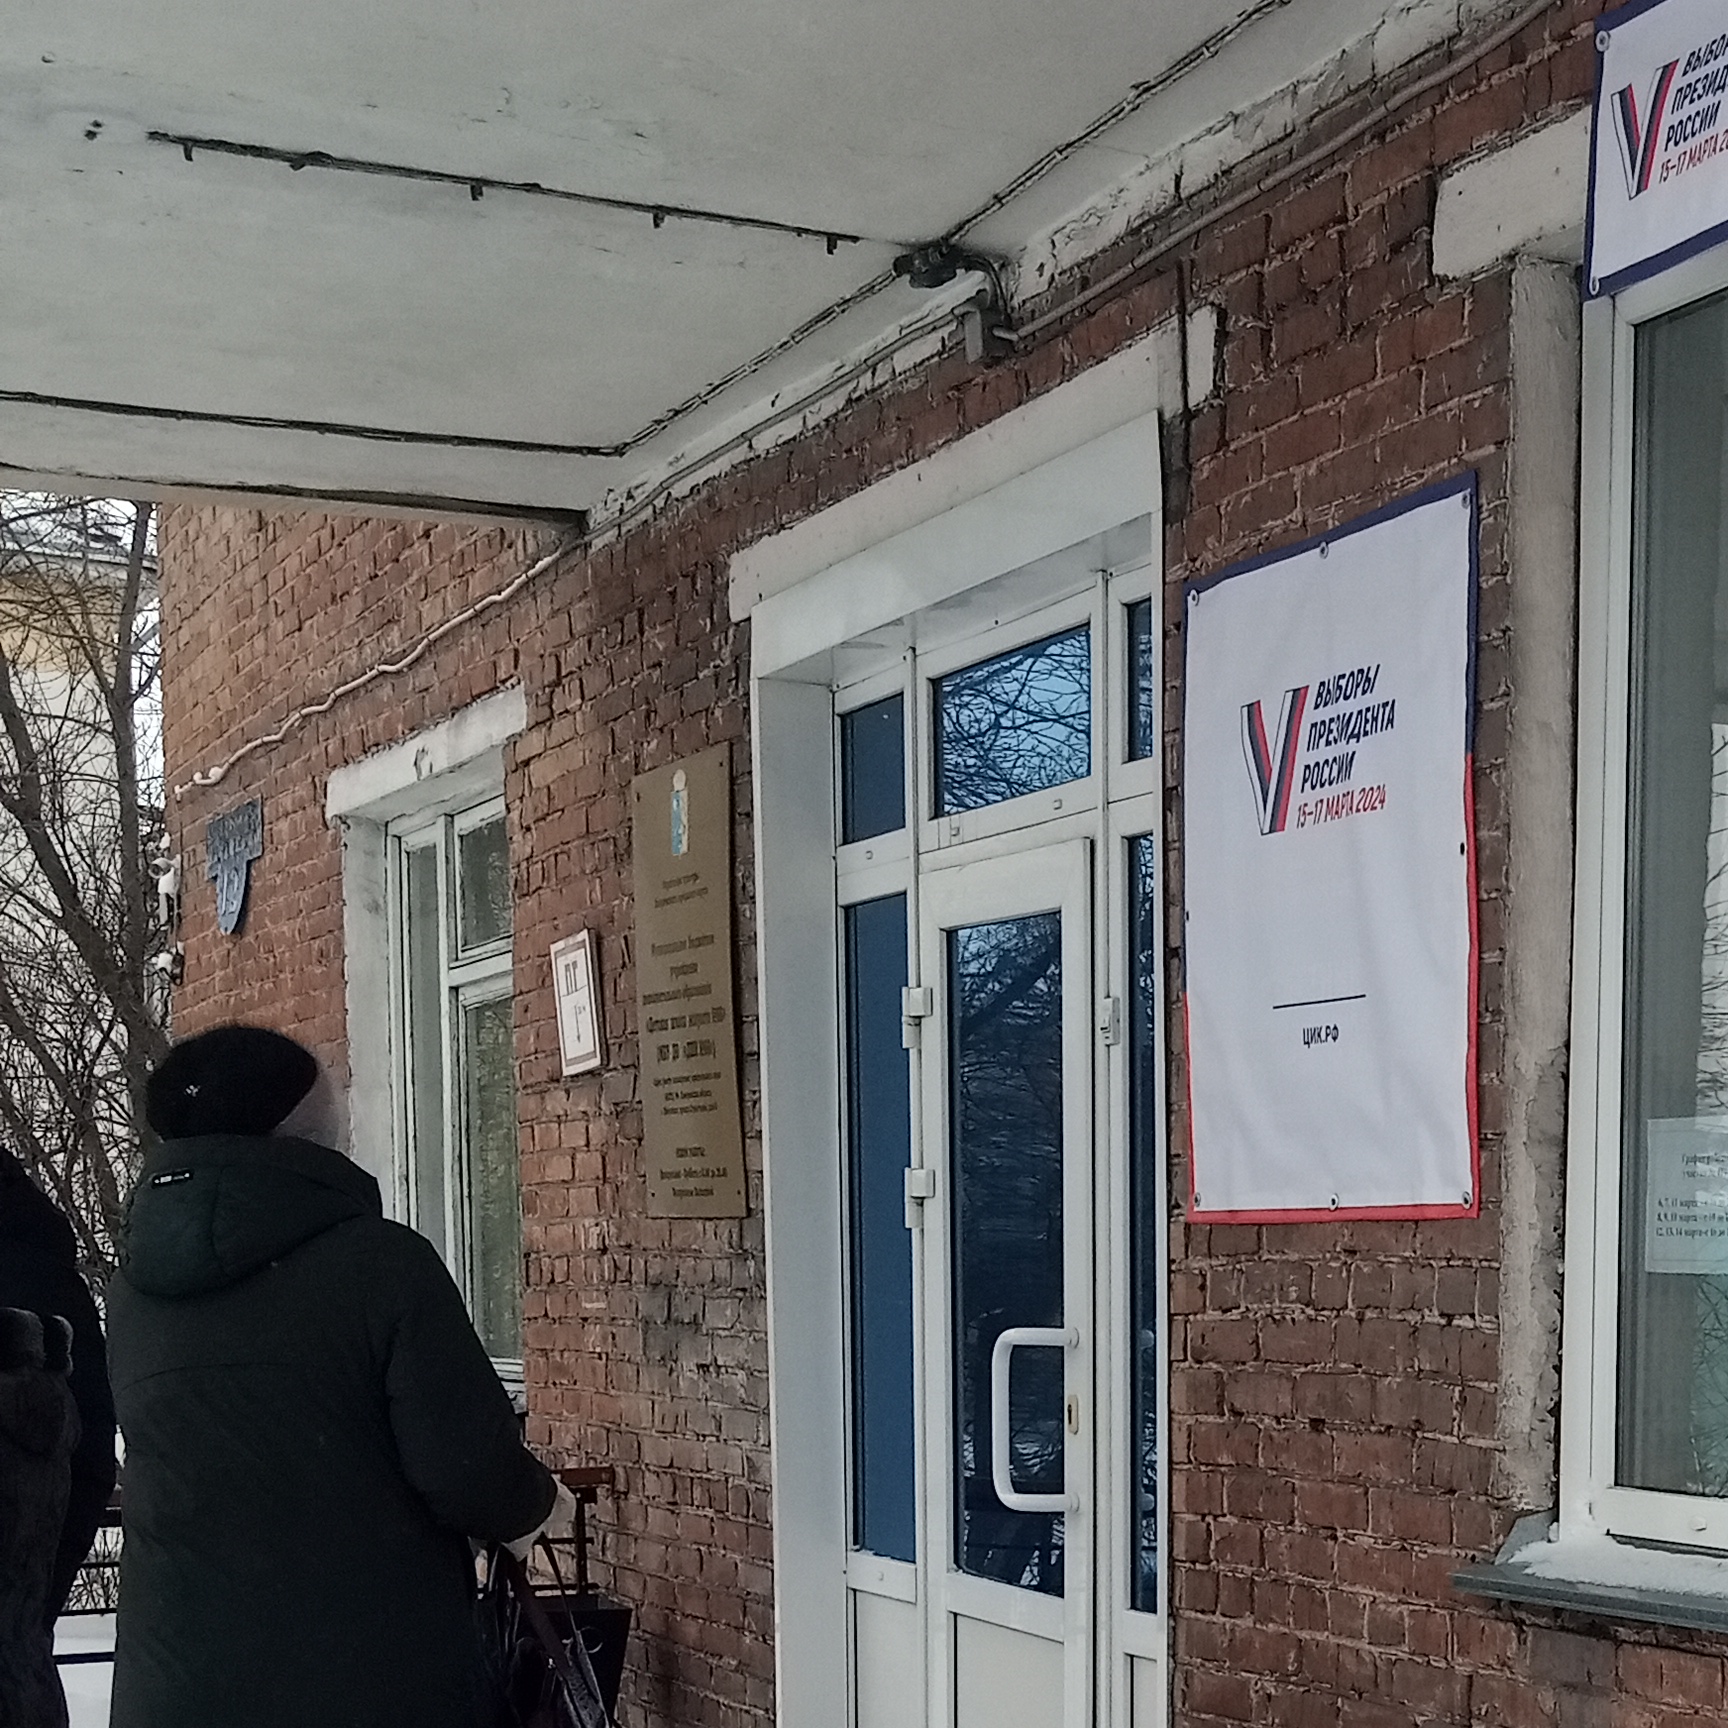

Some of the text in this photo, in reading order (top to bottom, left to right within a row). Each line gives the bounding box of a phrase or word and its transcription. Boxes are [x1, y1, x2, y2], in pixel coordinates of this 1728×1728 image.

[1664, 100, 1721, 152] РОССИИ
[1687, 133, 1719, 171] МАРТА
[1313, 664, 1380, 710] ВЫБОРЫ
[1306, 699, 1396, 752] ПРЕЗИДЕНТА
[1300, 751, 1356, 794] РОССИИ
[1324, 789, 1354, 823] МАРТА
[1355, 784, 1386, 813] 2024
[1303, 1024, 1339, 1049] ЦИК.РФ
